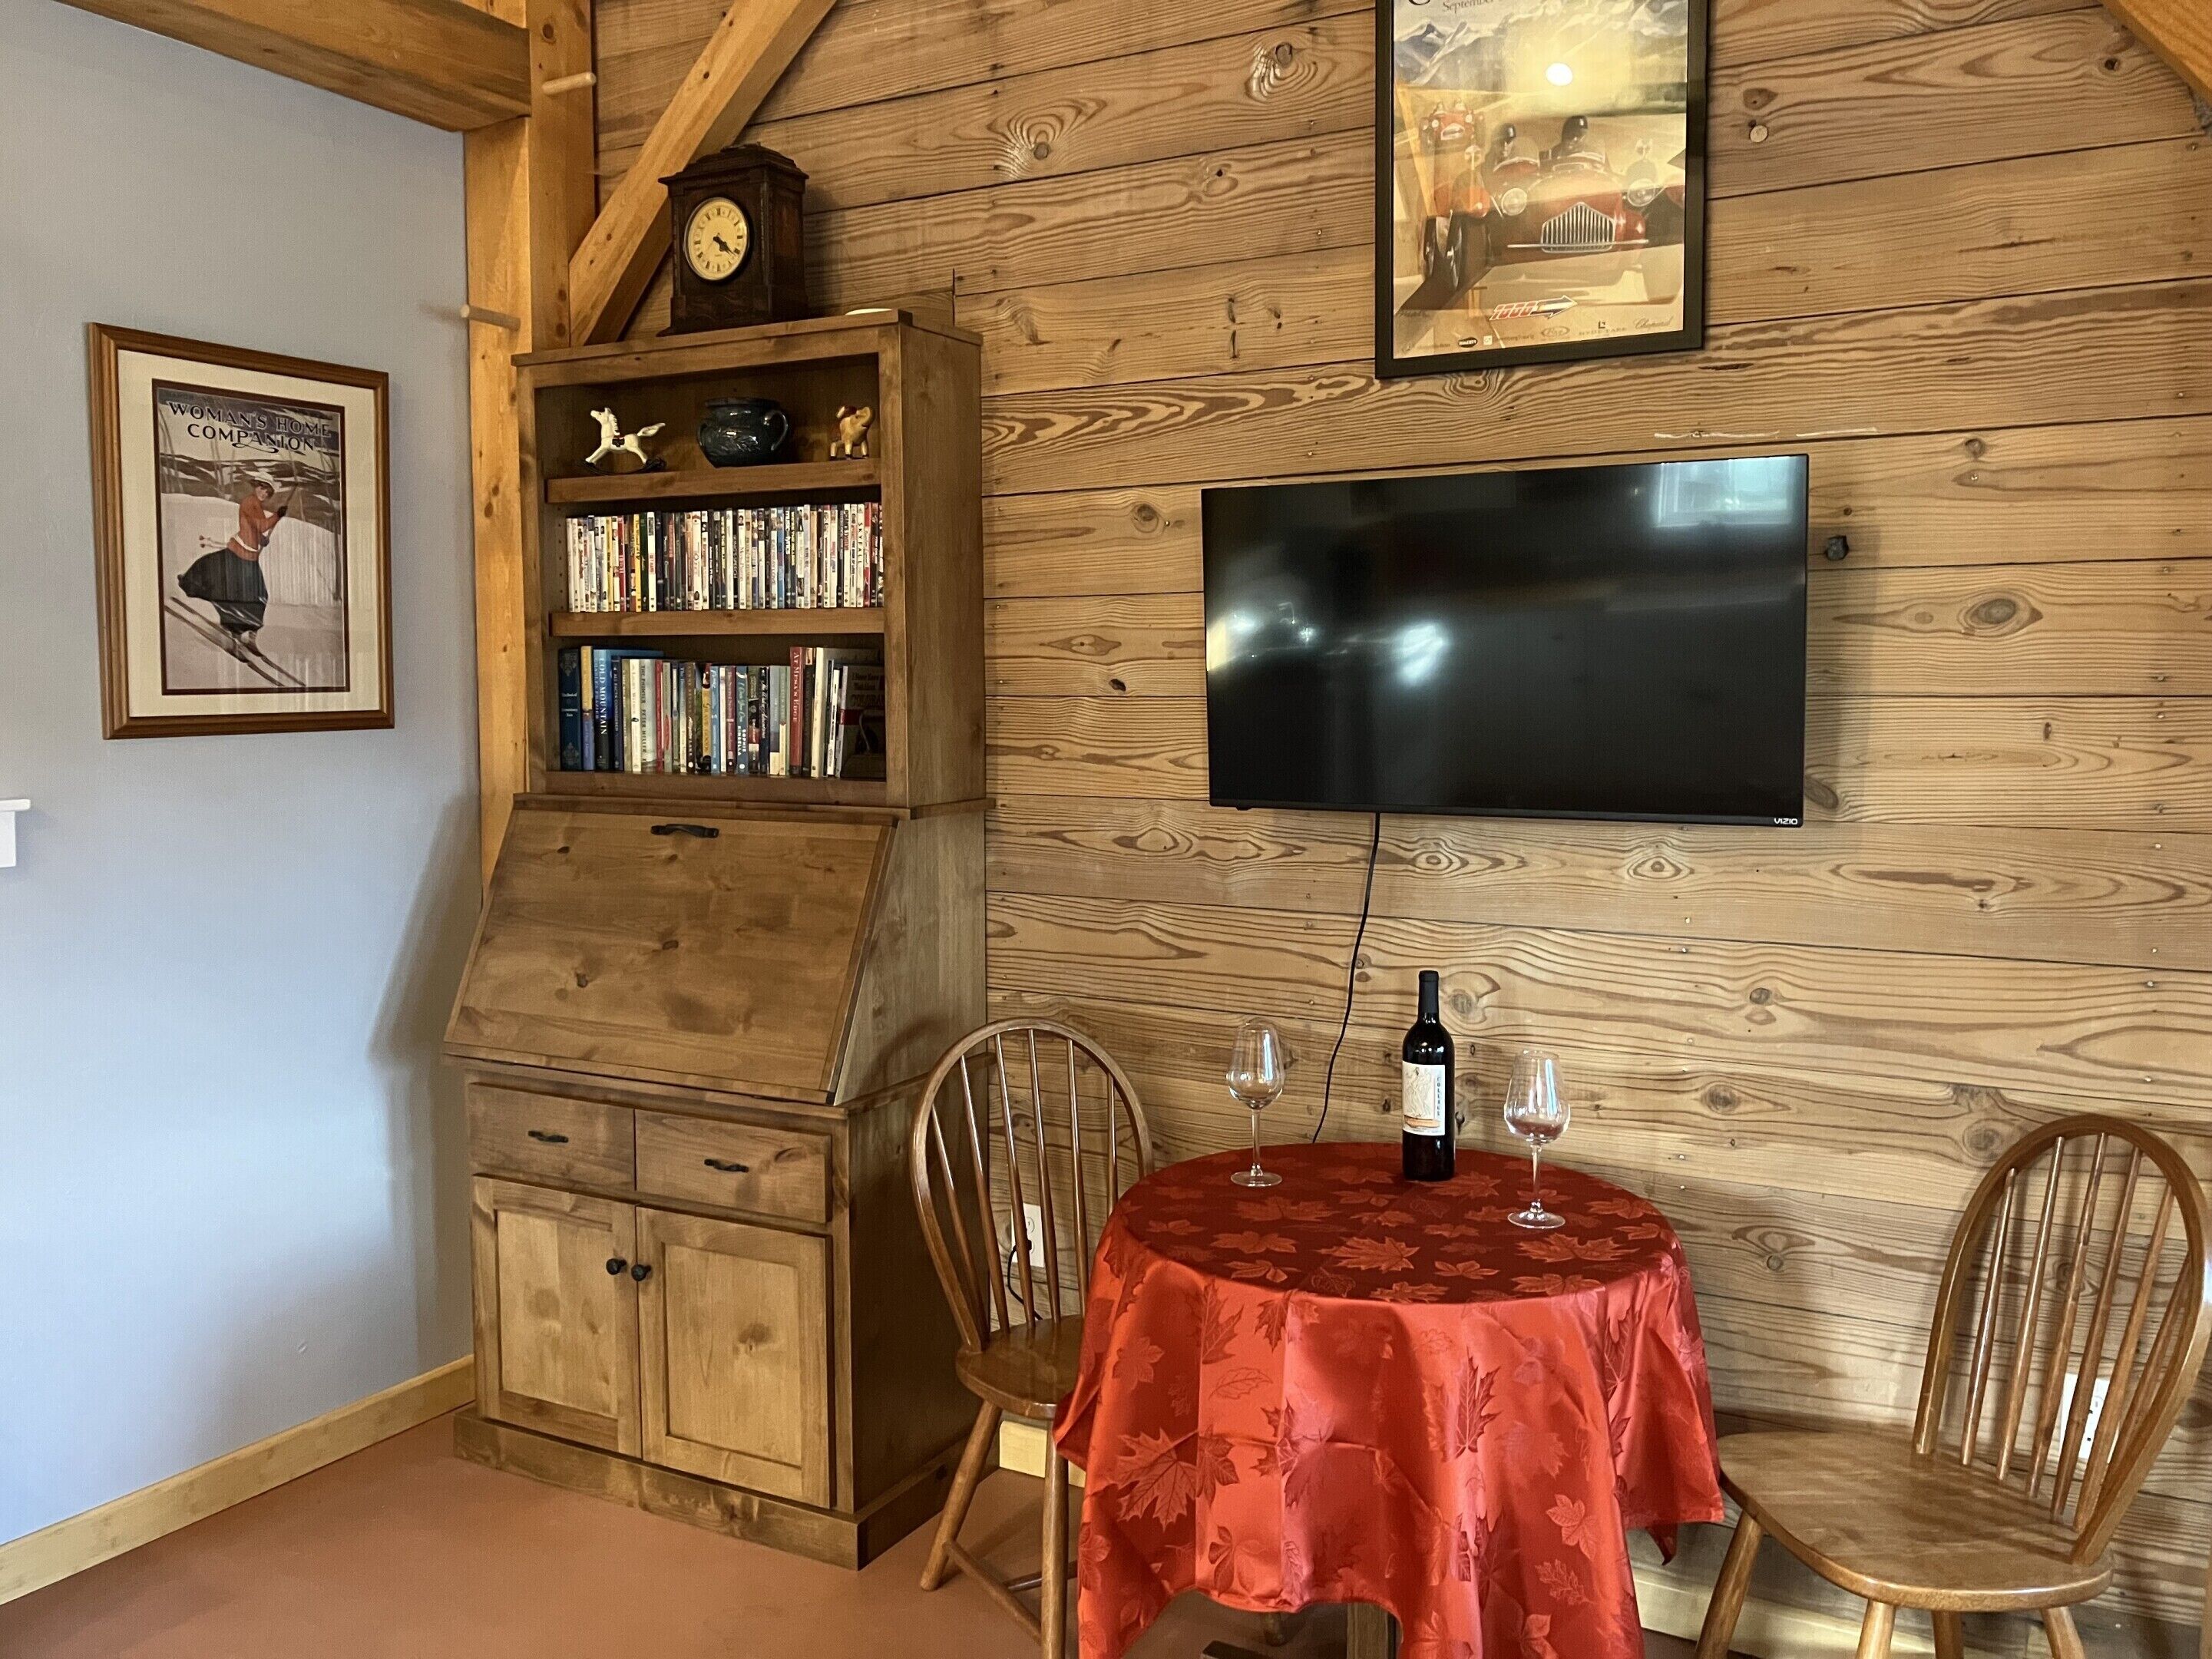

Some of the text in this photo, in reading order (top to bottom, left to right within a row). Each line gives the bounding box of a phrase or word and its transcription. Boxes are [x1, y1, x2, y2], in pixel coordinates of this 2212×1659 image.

[167, 401, 332, 438] WOMAN'S HOME
[187, 424, 315, 453] COMPANION
